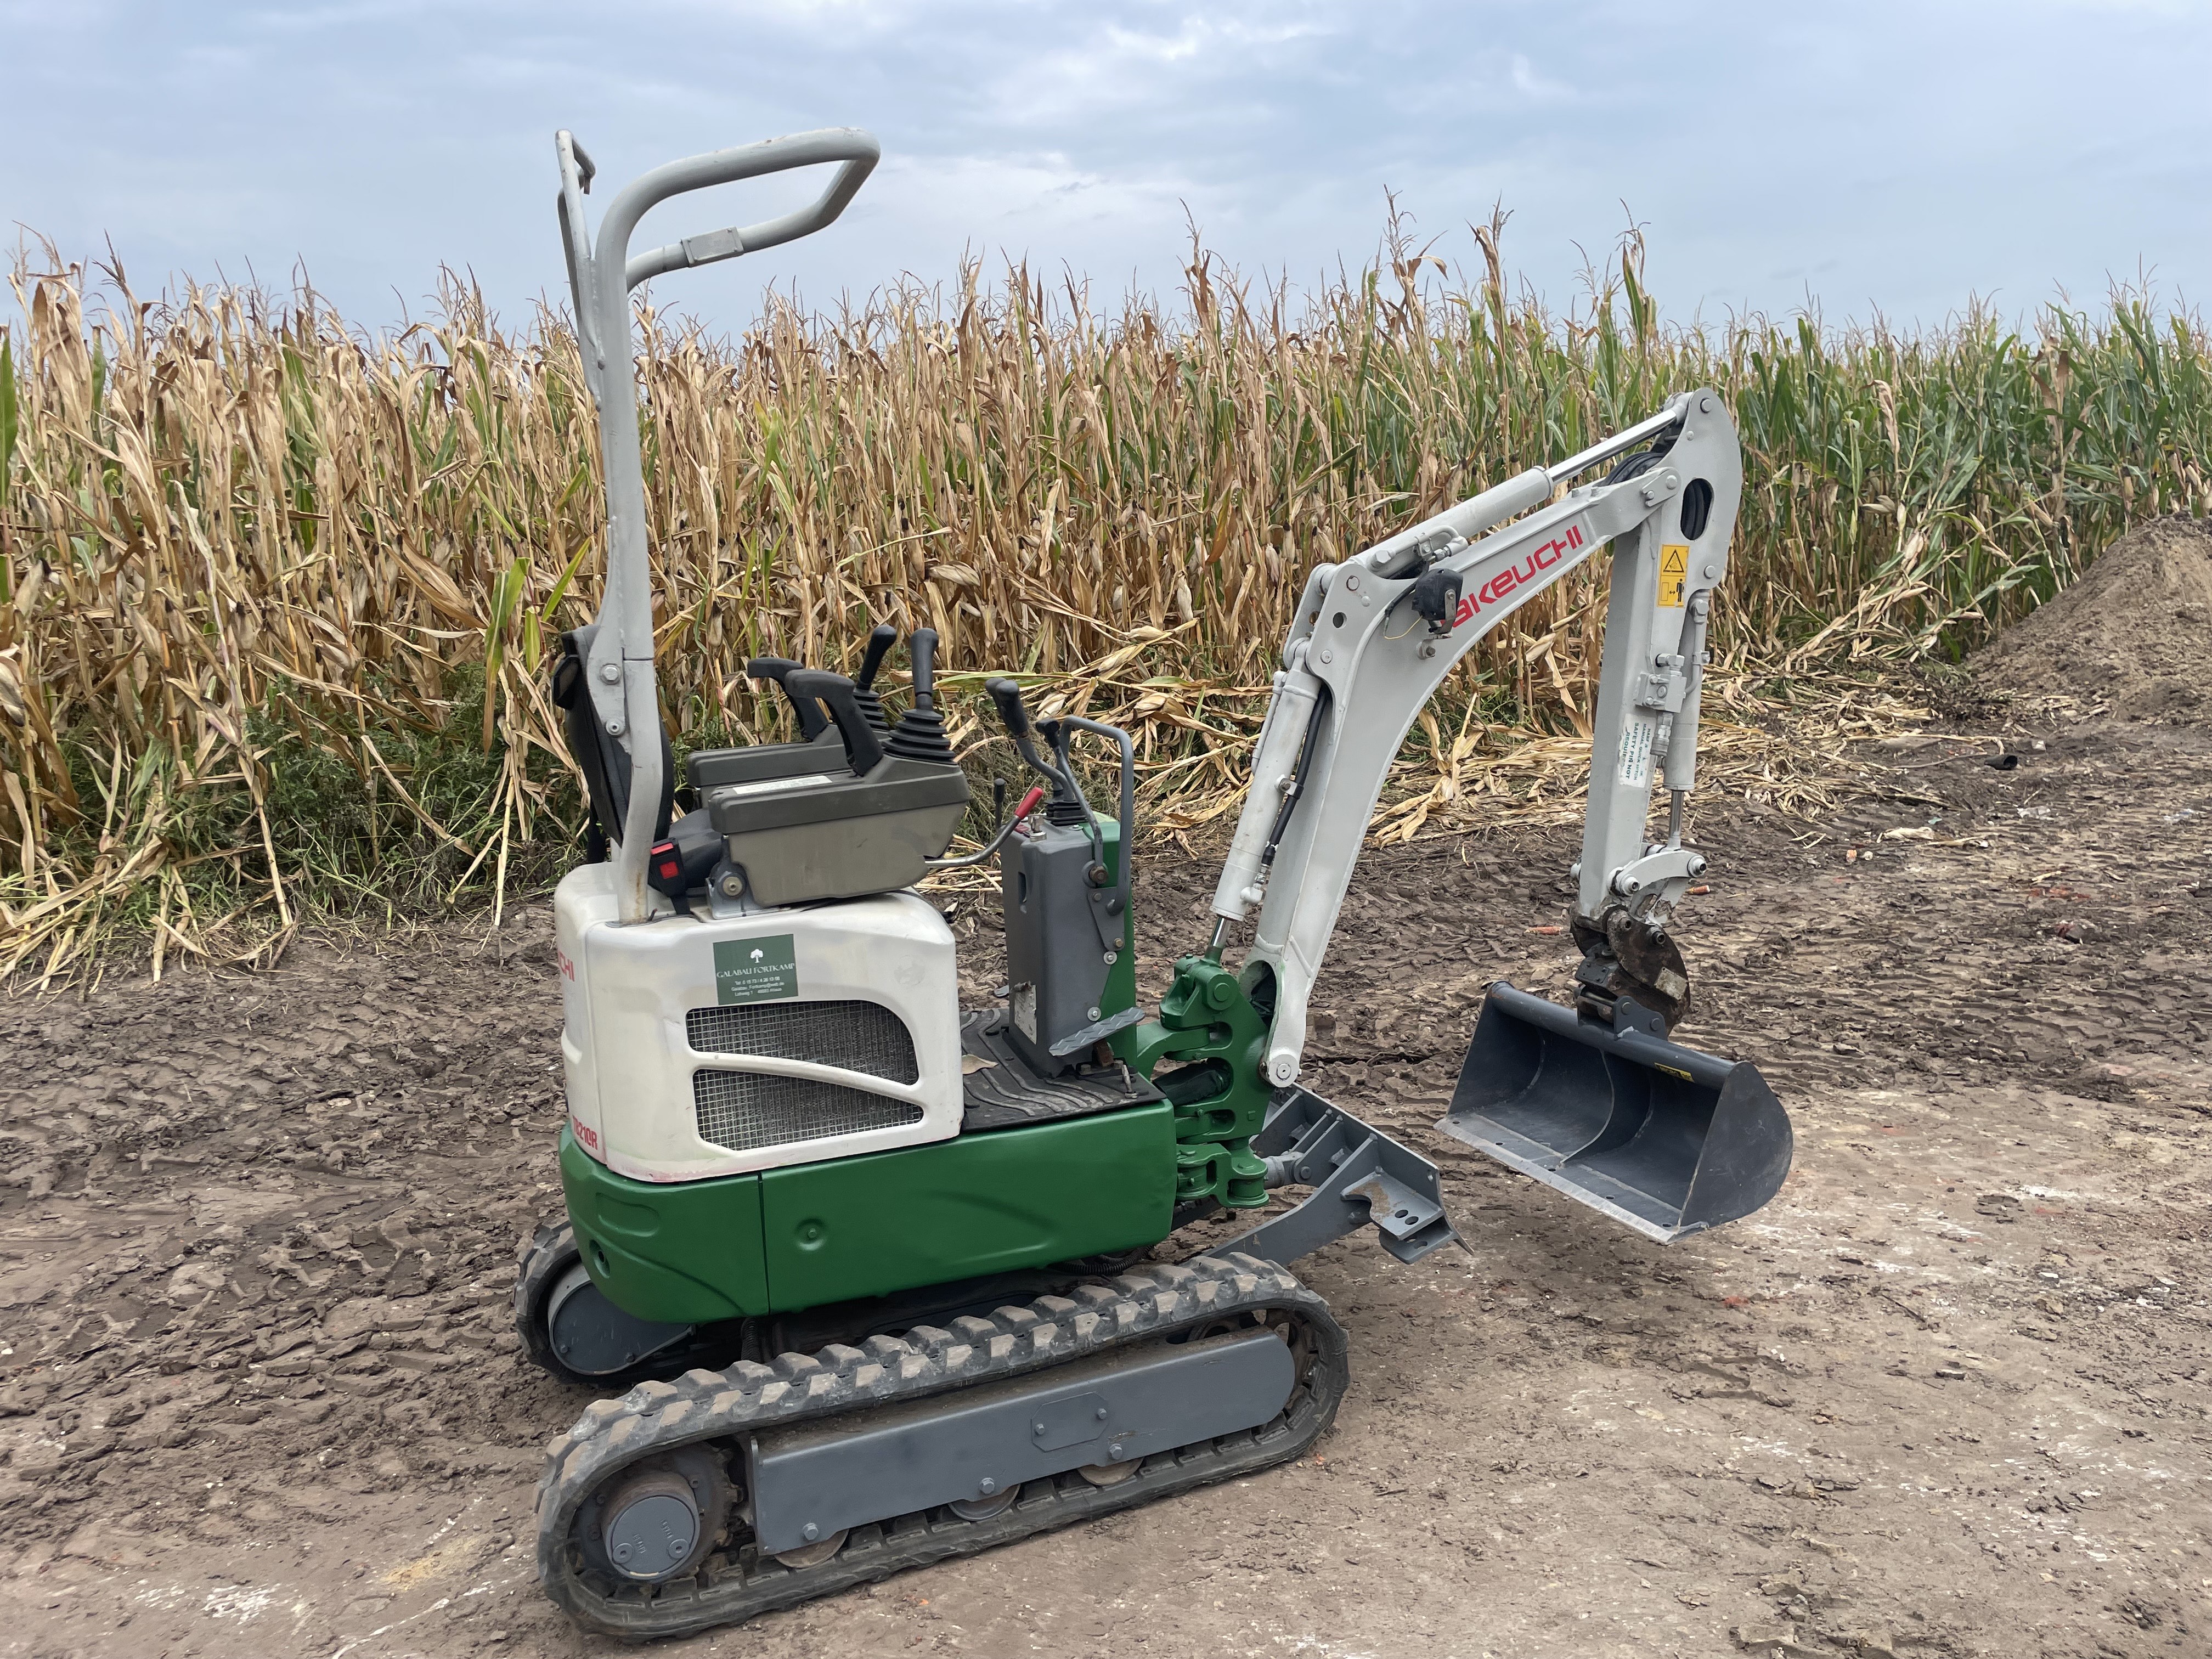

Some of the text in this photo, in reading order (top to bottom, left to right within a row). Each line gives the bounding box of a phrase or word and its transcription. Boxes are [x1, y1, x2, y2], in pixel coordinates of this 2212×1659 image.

[1440, 525, 1583, 628] AKEUCHI
[1631, 723, 1639, 749] SAFETY
[716, 963, 795, 978] GALABAU FORTKAMP
